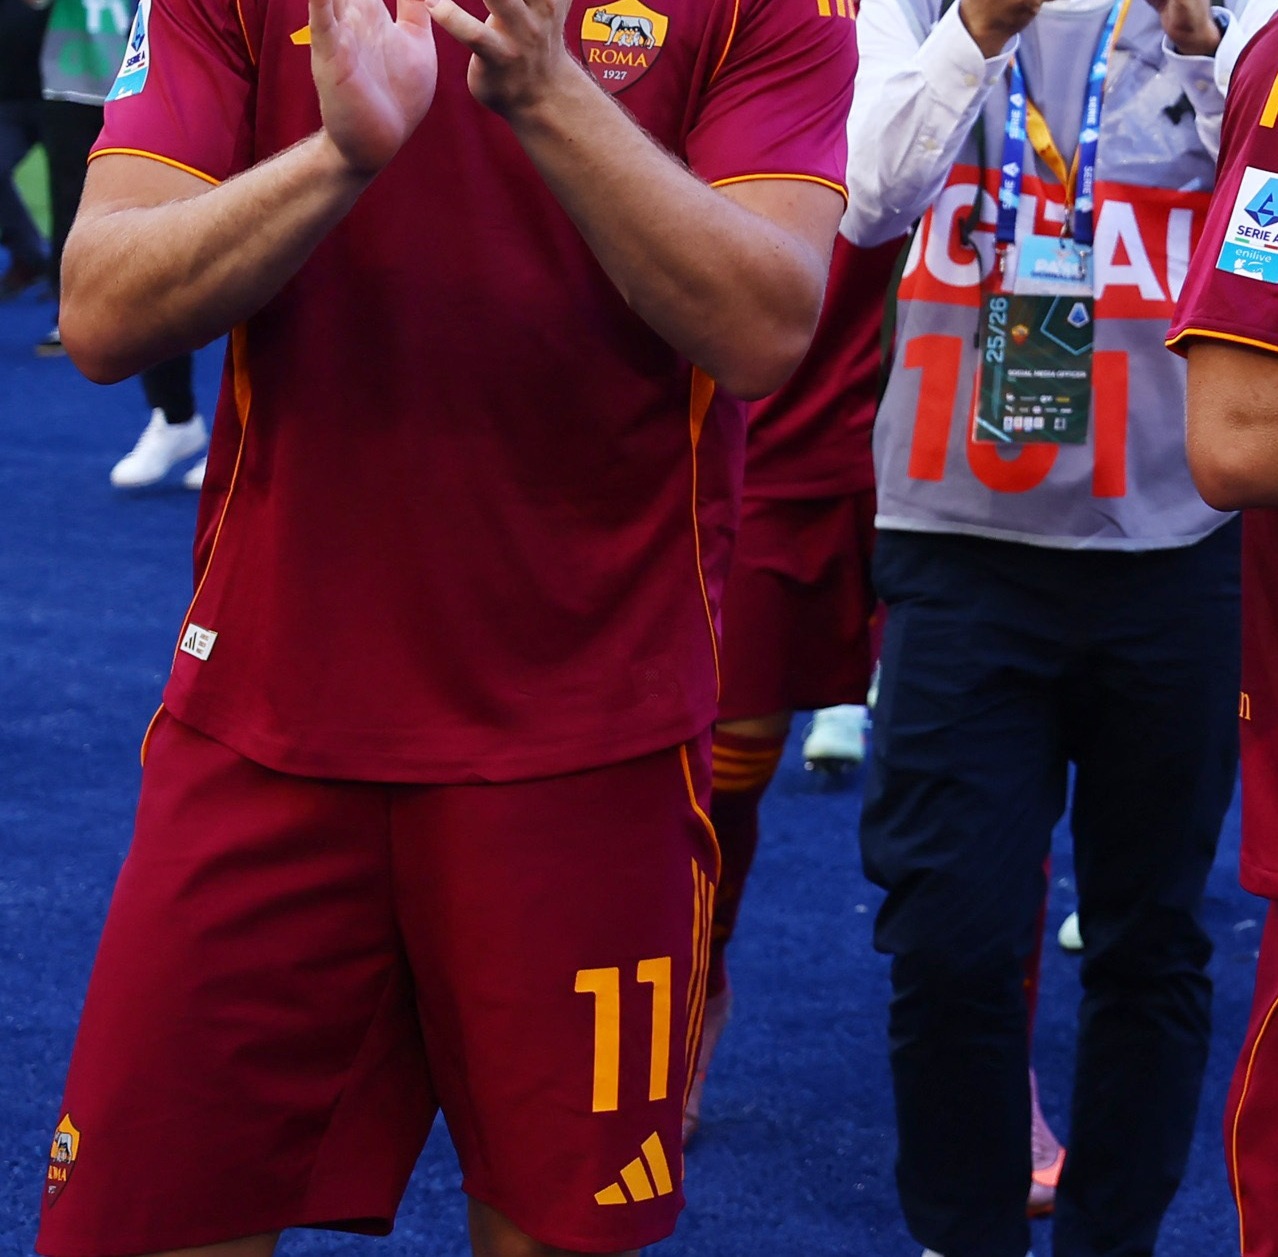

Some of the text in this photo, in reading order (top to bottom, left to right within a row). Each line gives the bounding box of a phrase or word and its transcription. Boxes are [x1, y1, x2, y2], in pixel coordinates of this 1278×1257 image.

[588, 47, 649, 68] ROMA
[602, 69, 627, 80] 1927
[1236, 225, 1272, 242] SERIE
[1235, 248, 1272, 263] enilive
[986, 296, 1008, 363] 25/26
[574, 956, 671, 1112] 11
